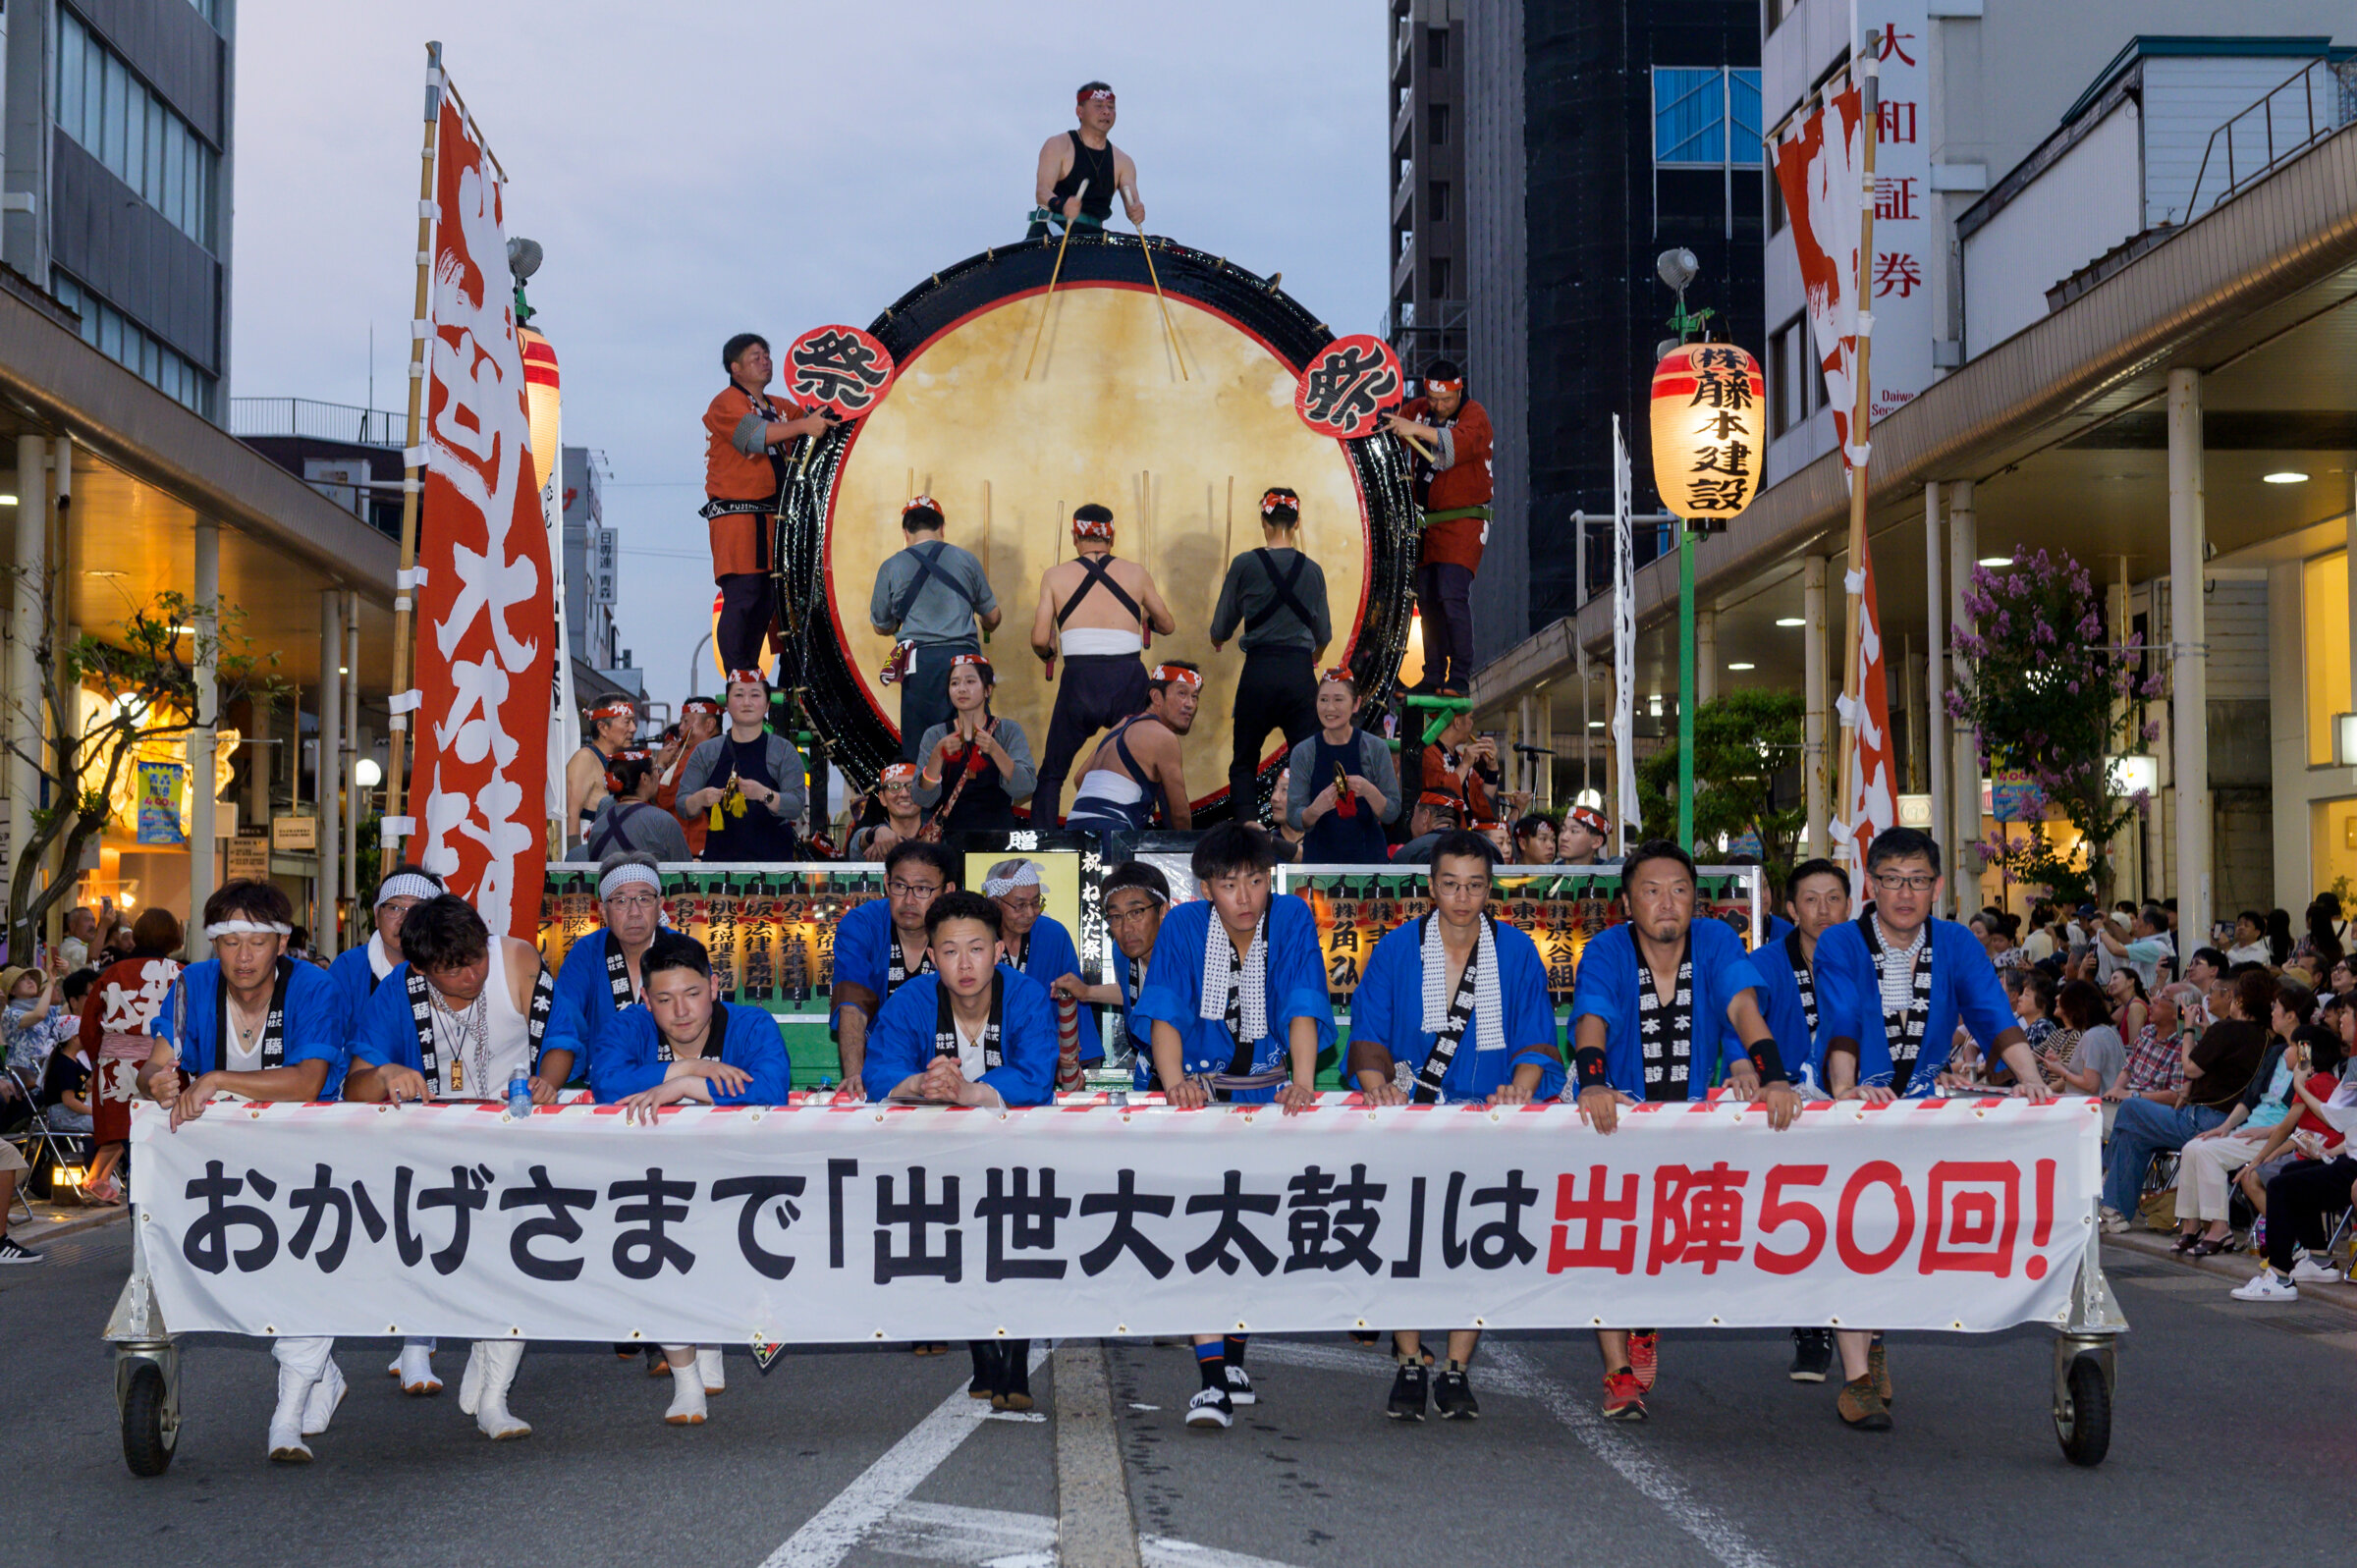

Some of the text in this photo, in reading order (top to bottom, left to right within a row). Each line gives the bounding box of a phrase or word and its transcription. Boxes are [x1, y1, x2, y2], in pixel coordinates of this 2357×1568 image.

[1873, 23, 1922, 298] 大和証券
[791, 329, 892, 410] 祭
[1304, 341, 1398, 435] 祭
[1005, 830, 1039, 851] 贈
[1081, 850, 1103, 961] 祝 ねぶた祭
[183, 1155, 2057, 1285] おかげさまで「出世大太鼓」は出陣50回!
